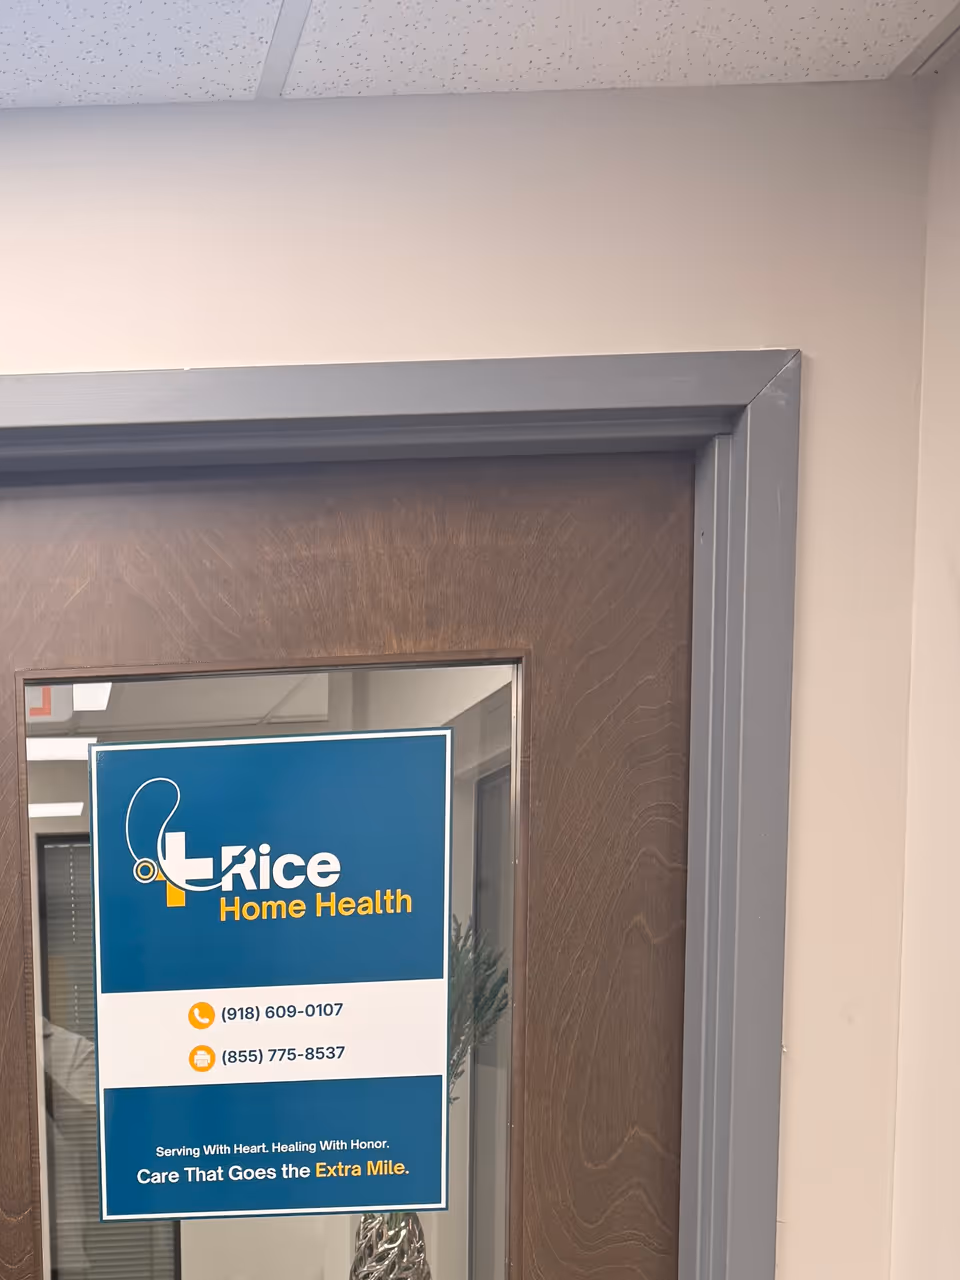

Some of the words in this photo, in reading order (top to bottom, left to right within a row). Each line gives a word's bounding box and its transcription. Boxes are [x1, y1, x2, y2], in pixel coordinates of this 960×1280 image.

[221, 843, 341, 891] Rice
[219, 897, 306, 922] Home
[315, 889, 413, 918] Health
[221, 1006, 260, 1023] (918)
[265, 1003, 344, 1019] 609-0107
[222, 1049, 263, 1066] (855)
[268, 1046, 345, 1062] 775-8537
[155, 1146, 201, 1158] Serving
[203, 1144, 231, 1155] With
[233, 1143, 269, 1154] Heart.
[271, 1141, 317, 1154] Healing
[319, 1140, 348, 1151] With
[350, 1139, 390, 1150] Honor.
[136, 1168, 180, 1185] Care
[184, 1166, 224, 1182] That
[228, 1165, 277, 1181] Goes
[281, 1163, 311, 1179] the
[315, 1162, 362, 1178] Extra
[366, 1160, 410, 1176] Mile.
